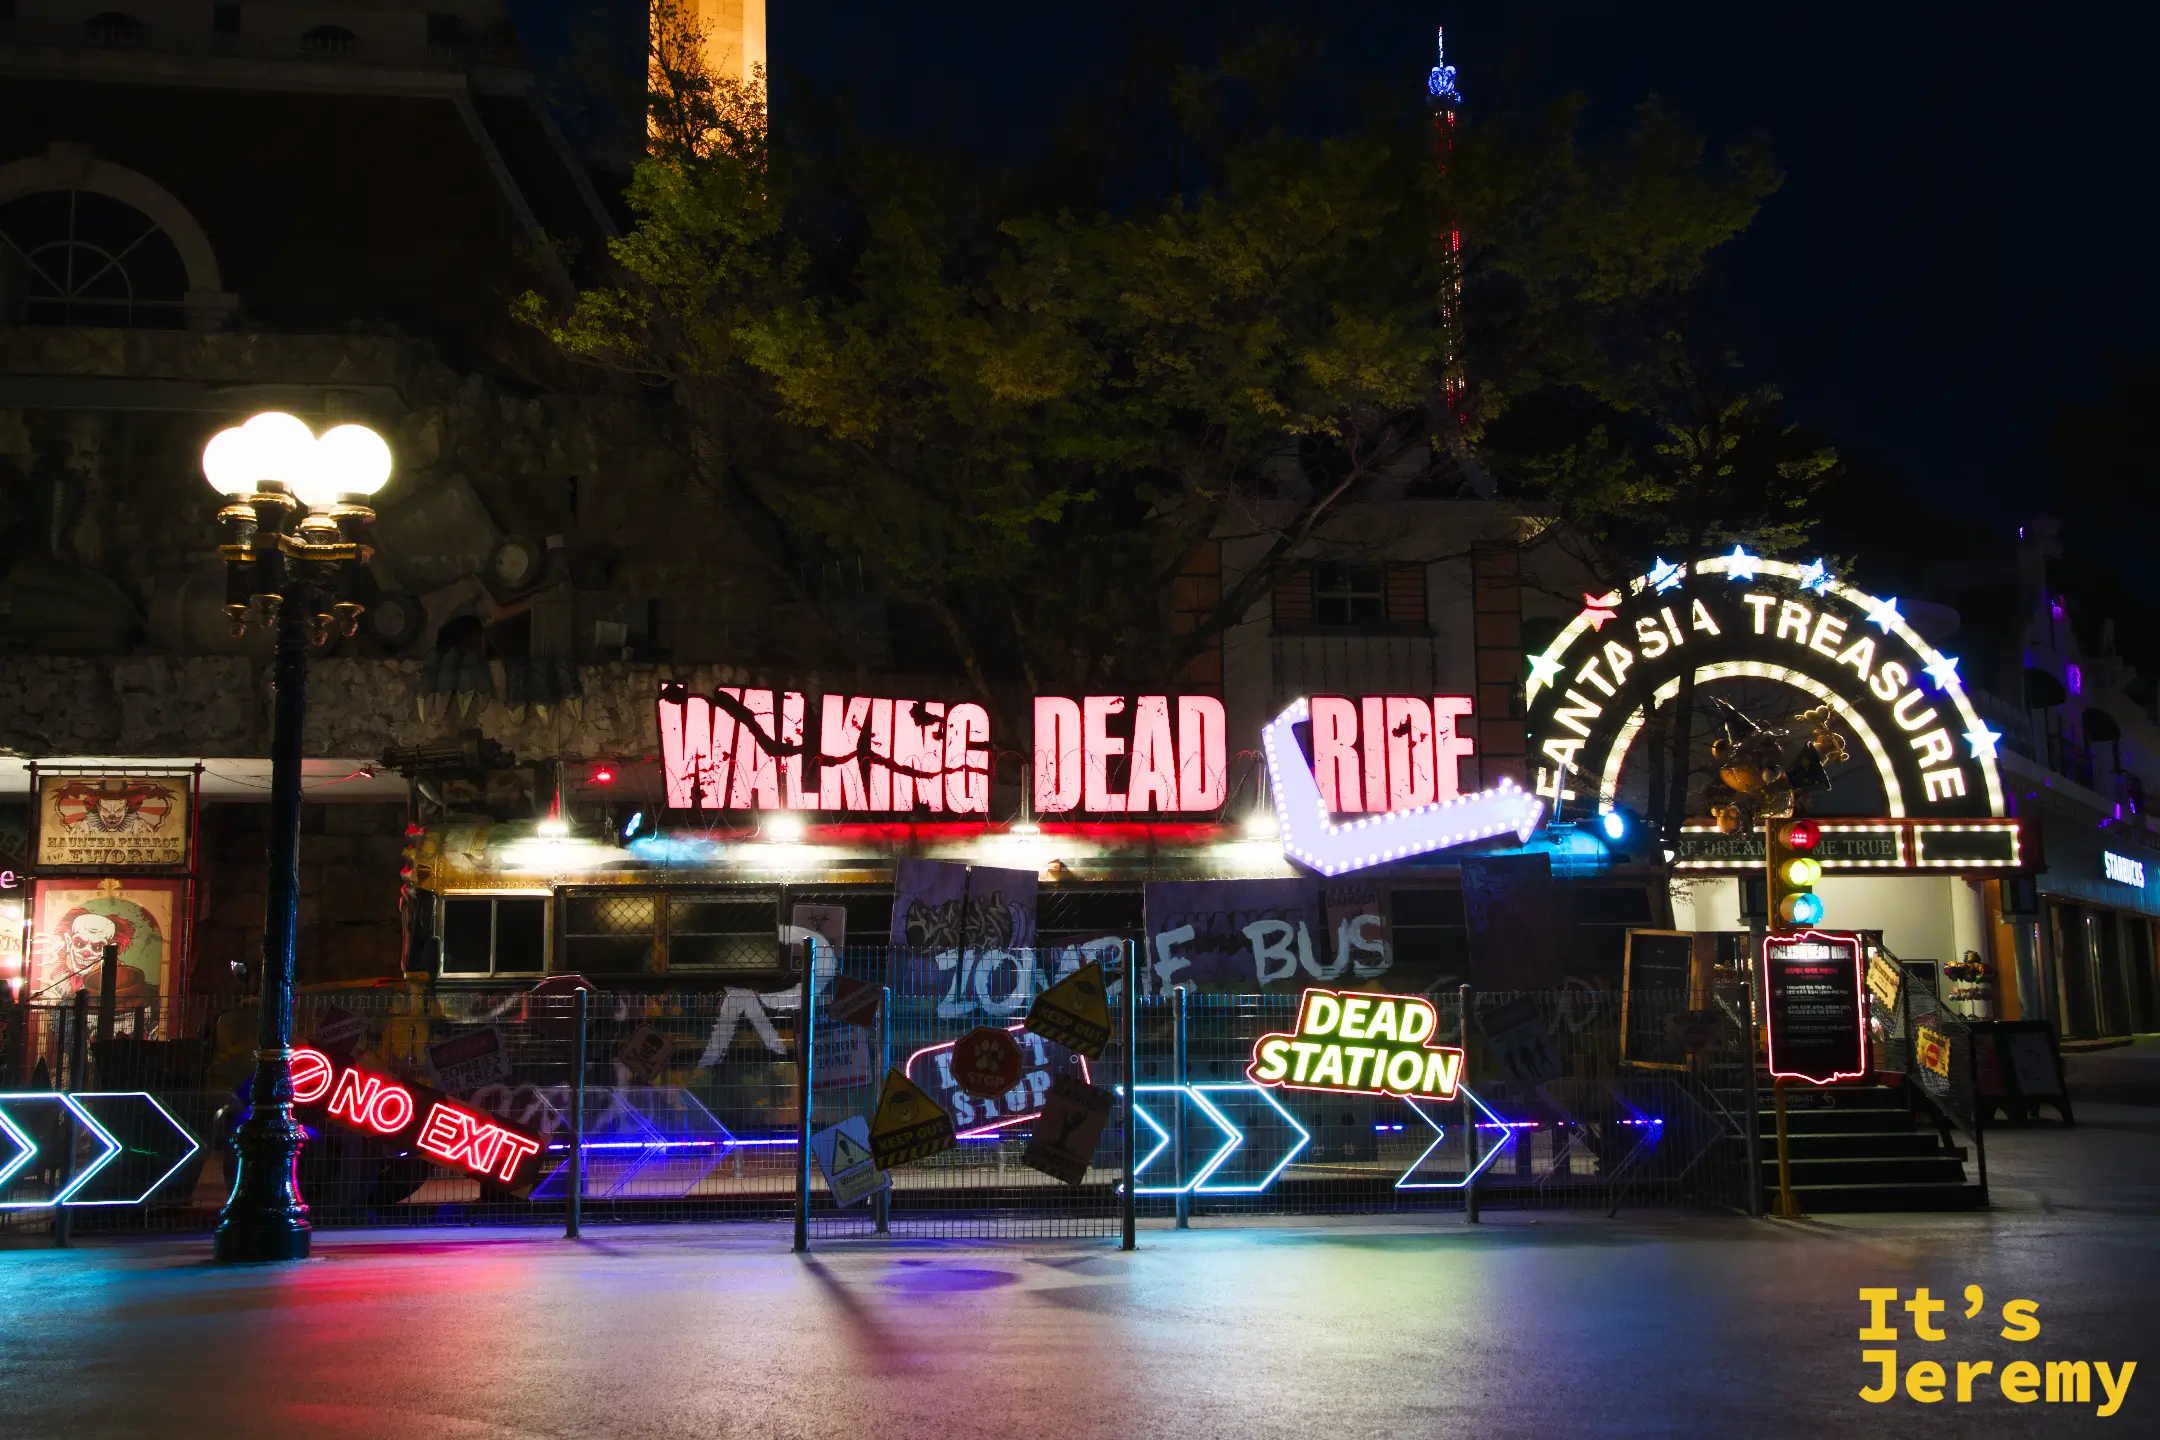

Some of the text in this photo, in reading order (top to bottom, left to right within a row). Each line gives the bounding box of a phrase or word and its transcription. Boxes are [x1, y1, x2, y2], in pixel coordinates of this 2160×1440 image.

[1536, 593, 1966, 802] FANTASIA TREASURE
[658, 684, 1475, 814] WALKING DEAD RIDE
[47, 837, 180, 848] HAUNTED PIERROT
[1704, 839, 1767, 857] DREAM
[1843, 839, 1892, 856] TRUE
[1242, 914, 1393, 988] BUS
[1036, 1003, 1104, 1042] KEEP OUT
[1304, 997, 1434, 1044] DEAD
[438, 1052, 502, 1081] ZOMBIES
[967, 1072, 1004, 1088] STOP
[1257, 1040, 1460, 1094] STATION
[328, 1067, 413, 1134] NO
[416, 1103, 540, 1182] EXIT
[878, 1123, 944, 1149] KEEP OUT
